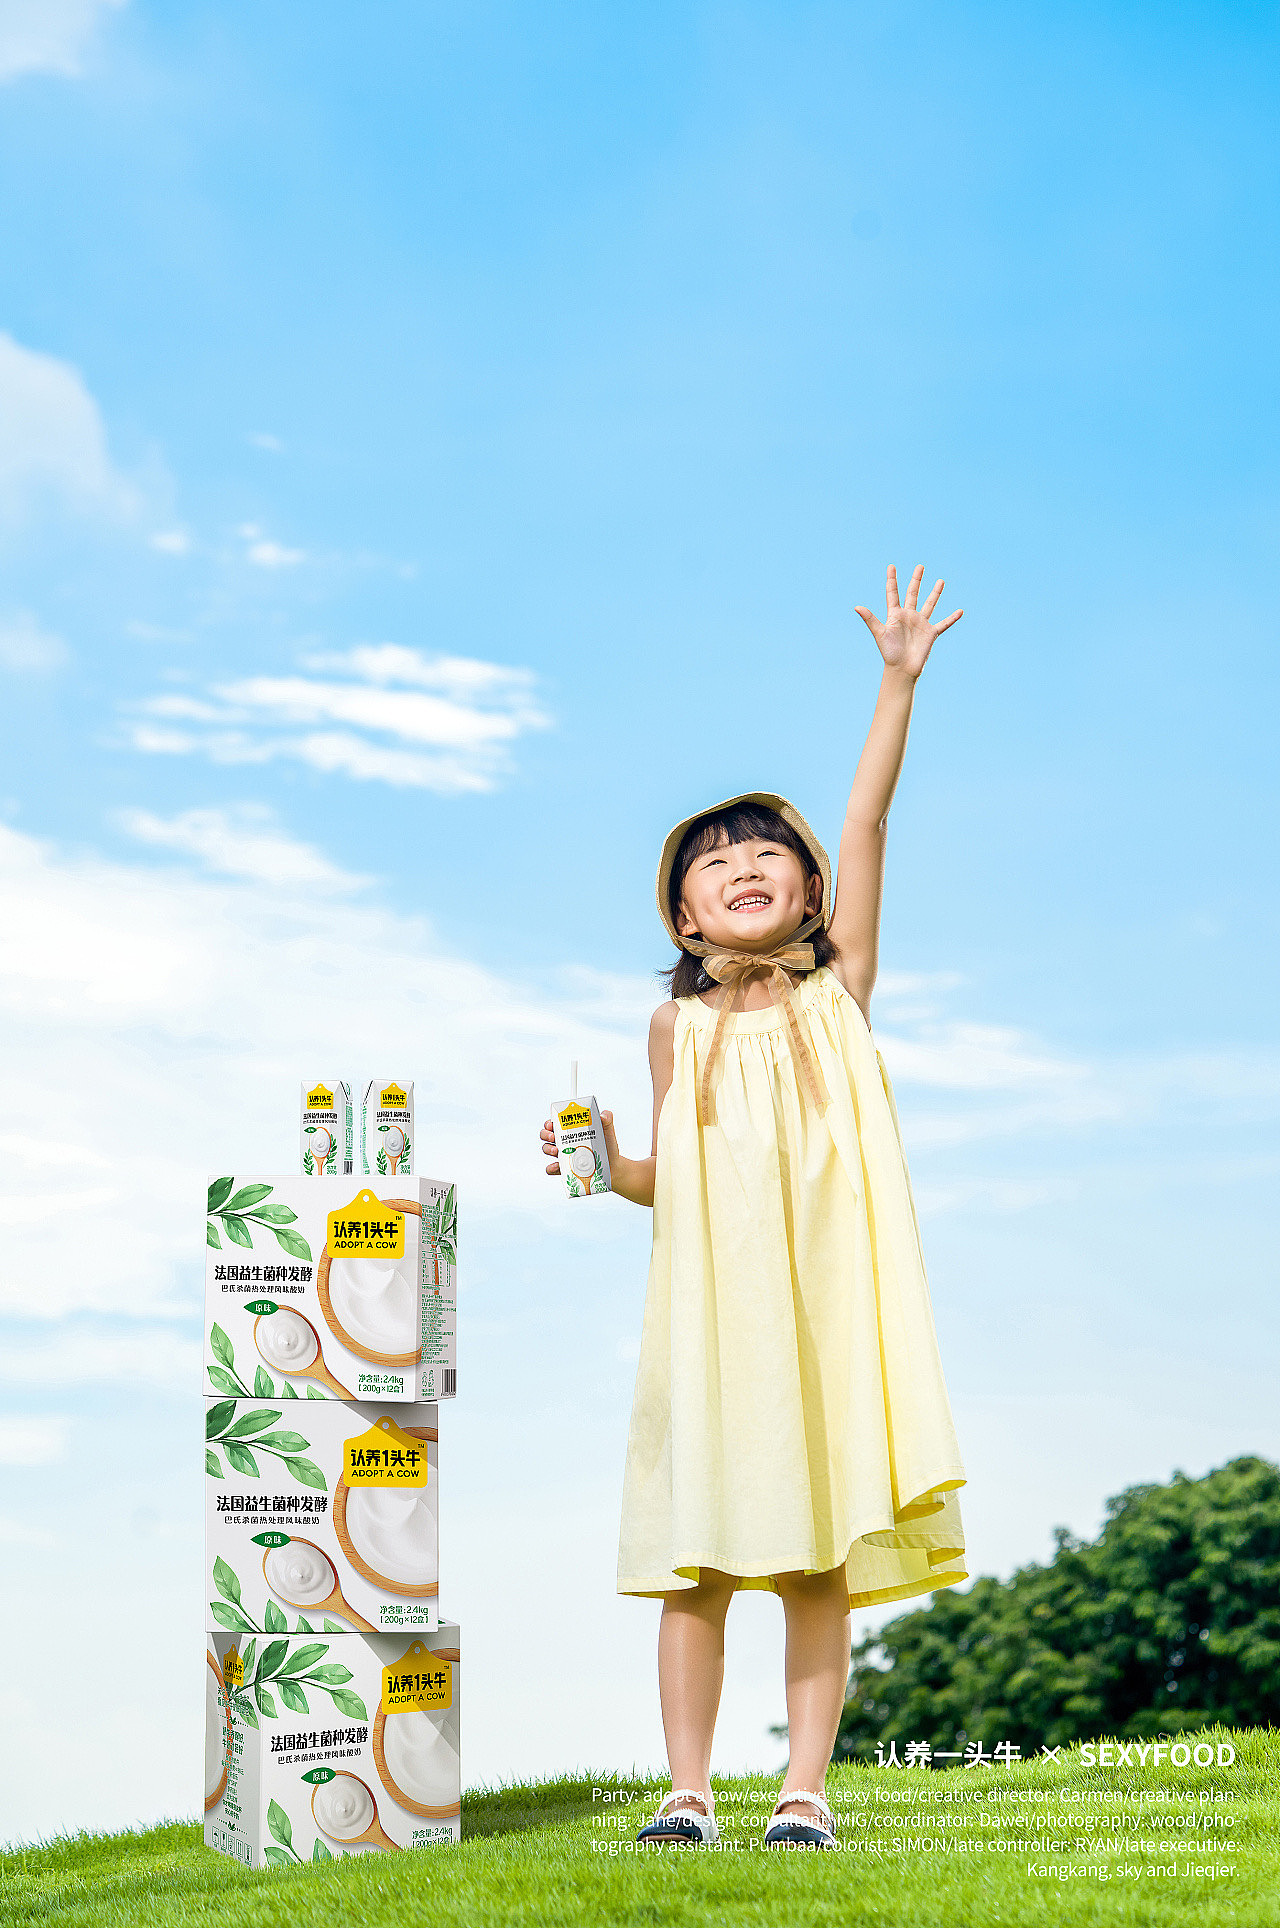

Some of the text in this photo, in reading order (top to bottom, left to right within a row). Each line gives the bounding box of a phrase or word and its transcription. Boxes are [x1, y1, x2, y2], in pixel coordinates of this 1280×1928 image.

[333, 1221, 399, 1238] 认养1头牛
[334, 1240, 398, 1249] ADOPT A COW
[214, 1264, 313, 1282] 法国益生菌种发酵
[255, 1303, 272, 1312] 原味
[351, 1448, 421, 1467] 认养1头牛
[351, 1469, 420, 1478] ADOPT A COW
[216, 1495, 328, 1513] 法国益生菌种发酵
[264, 1535, 282, 1544] 原味
[387, 1671, 447, 1693] 认养1头牛
[388, 1691, 446, 1704] ADOPT A COW
[270, 1726, 369, 1753] 法国益生菌种发酵
[312, 1770, 329, 1782] 原味
